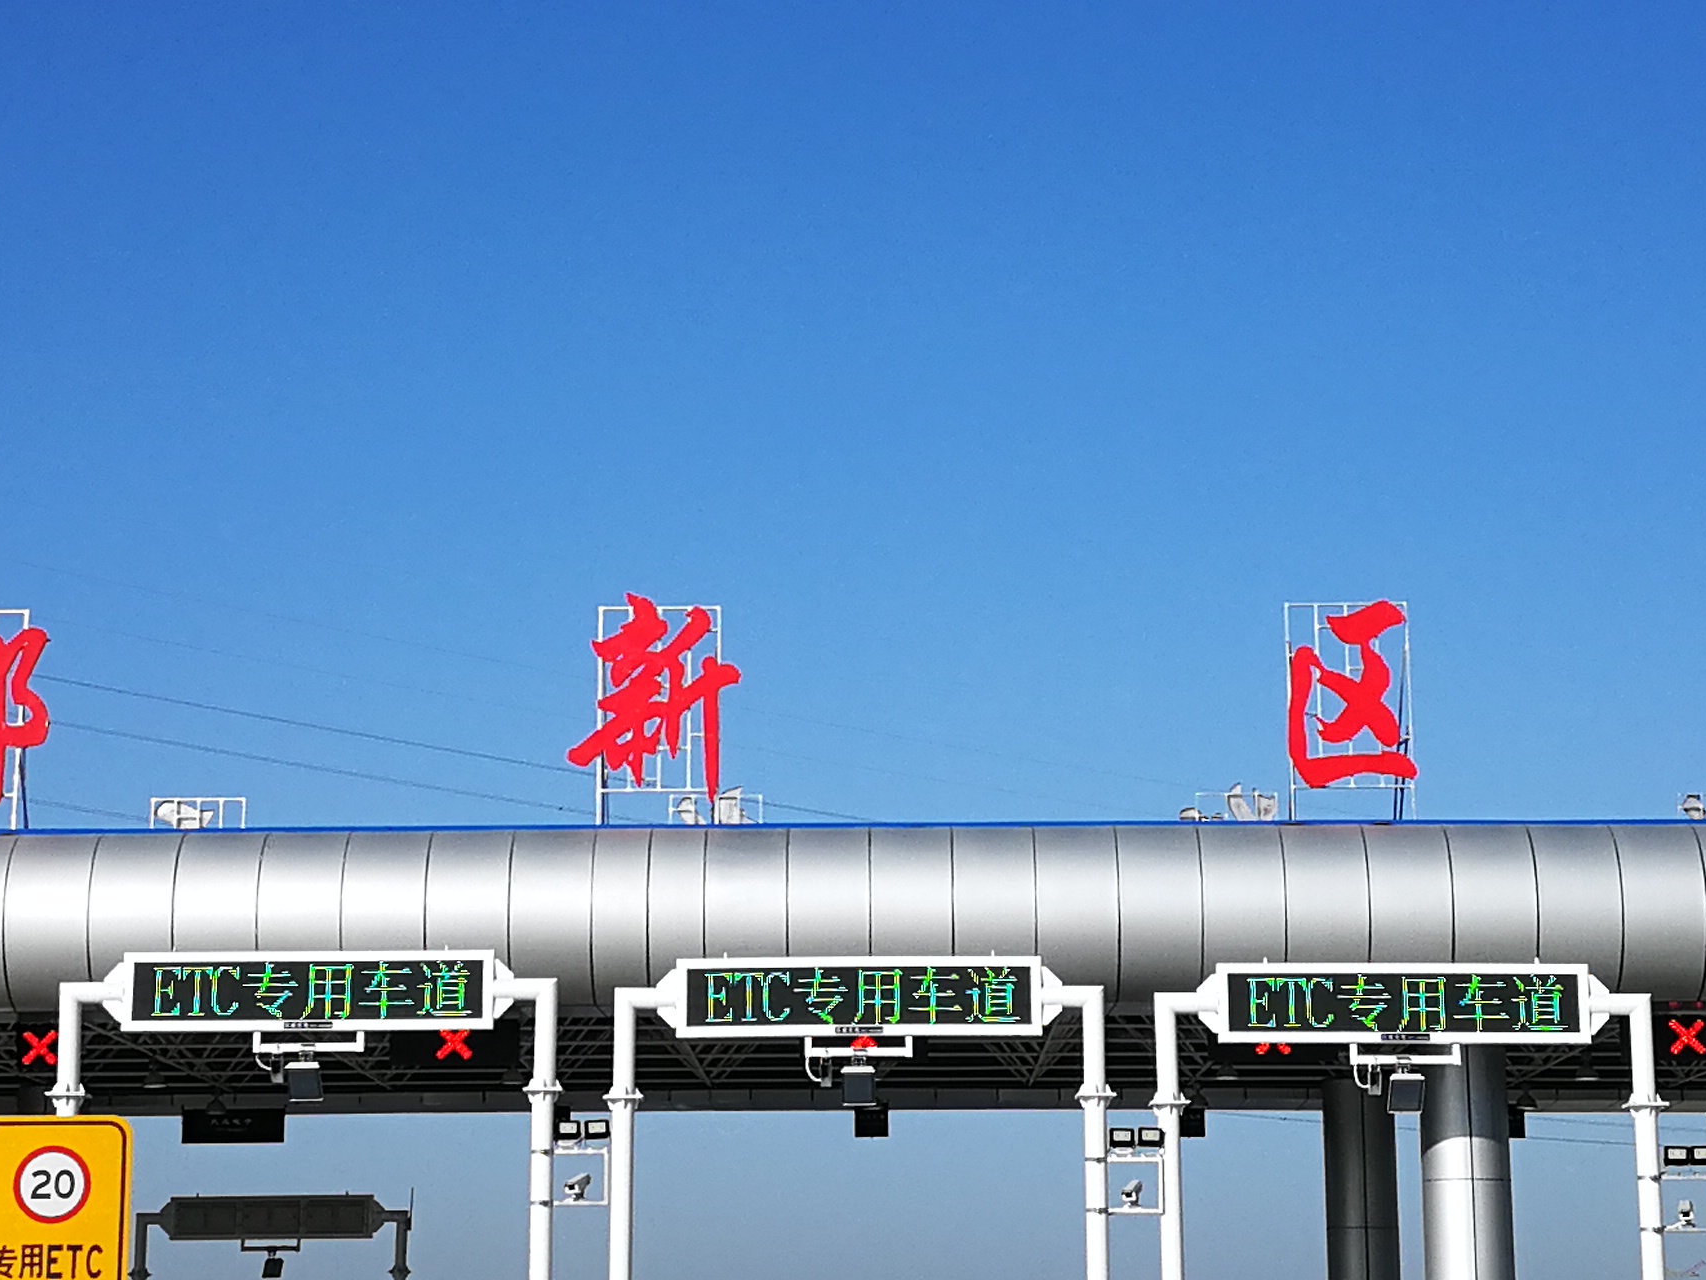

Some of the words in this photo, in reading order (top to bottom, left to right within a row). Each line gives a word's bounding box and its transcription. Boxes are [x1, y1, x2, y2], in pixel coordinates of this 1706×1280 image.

[154, 962, 475, 1020] ETC专用车道
[704, 967, 1020, 1026] ETC专用车道
[1246, 974, 1568, 1034] ETC专用车道
[29, 1168, 77, 1201] 20
